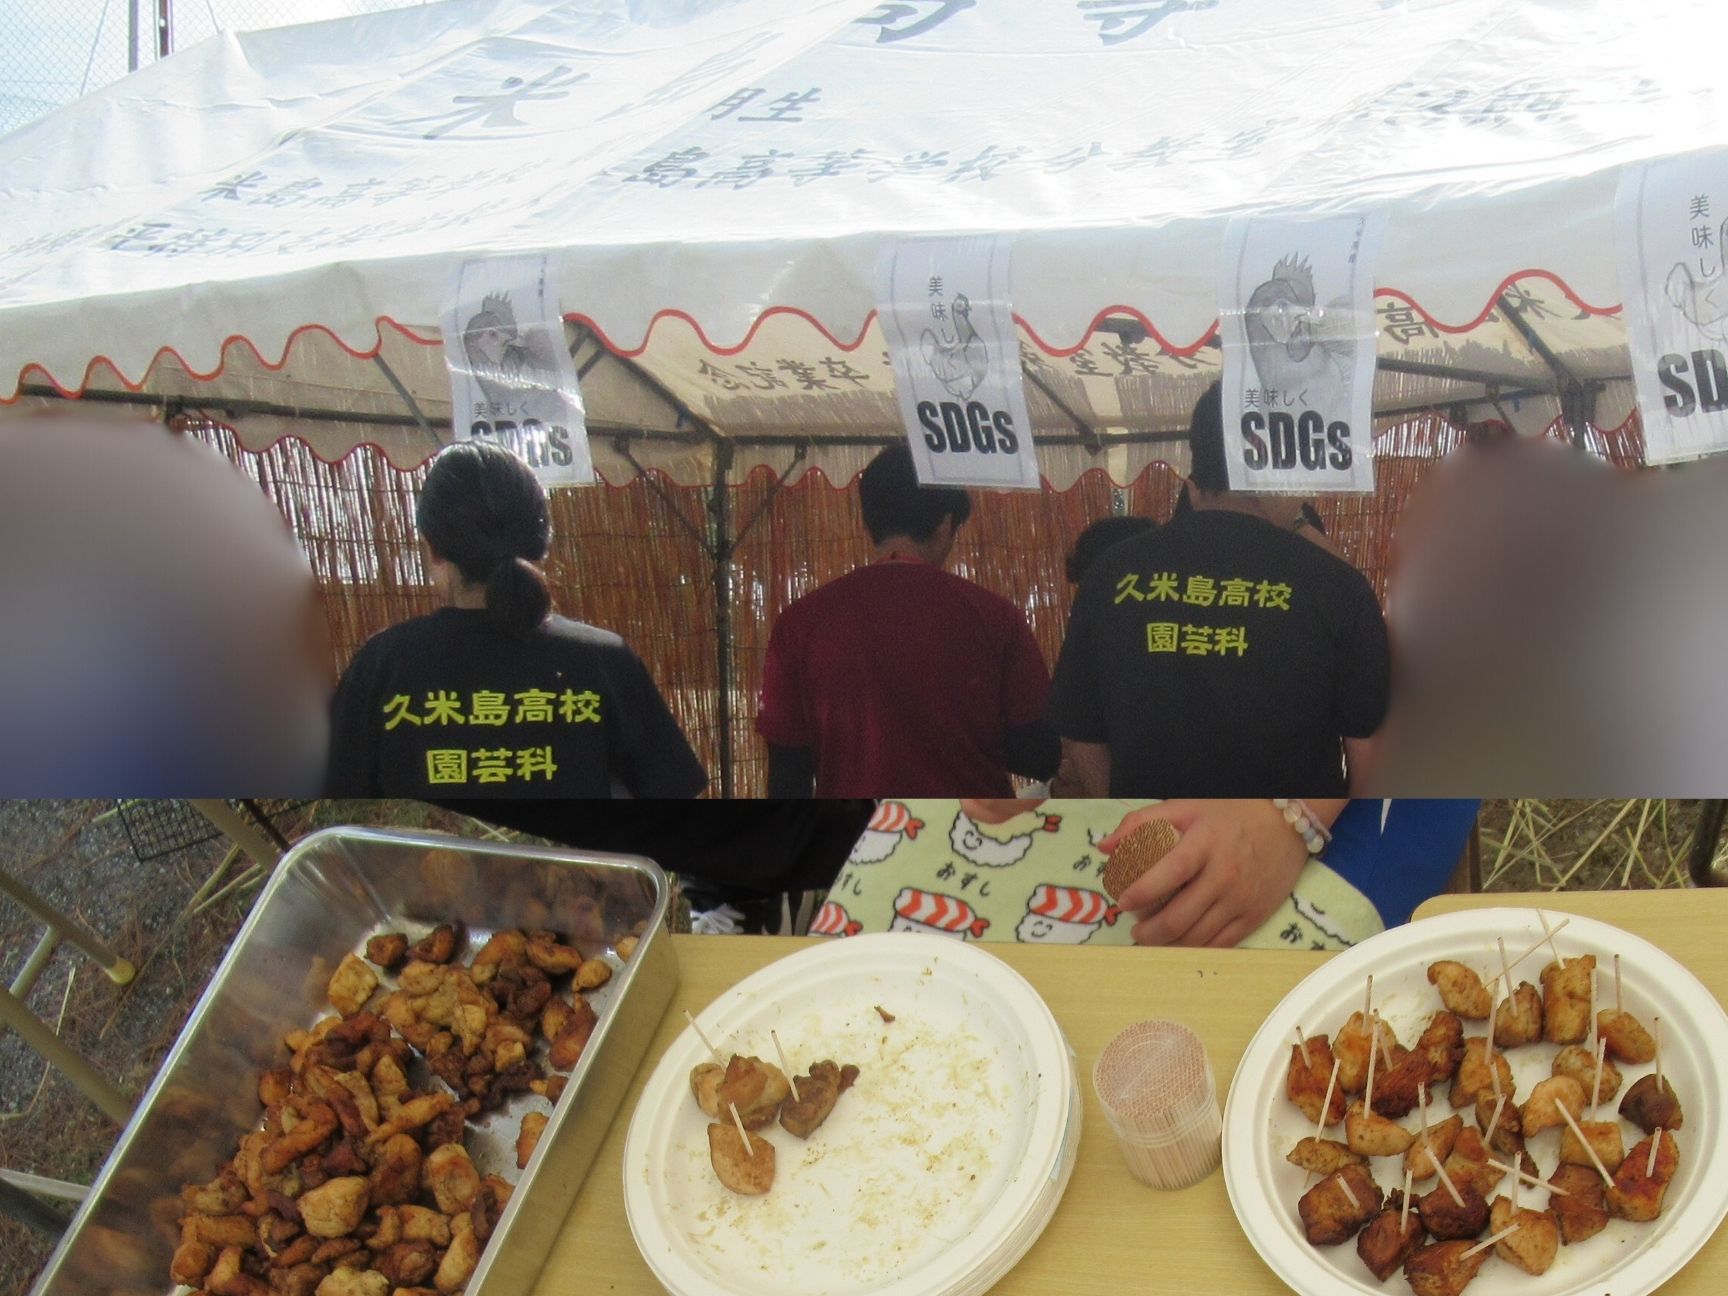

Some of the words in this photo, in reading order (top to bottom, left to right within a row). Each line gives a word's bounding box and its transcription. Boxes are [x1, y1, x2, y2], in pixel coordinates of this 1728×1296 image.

[1245, 388, 1308, 408] 美味しく
[917, 400, 1019, 454] SDGs
[1240, 410, 1353, 471] SDGs
[1113, 572, 1293, 612] 久米島高校
[1146, 621, 1249, 658] 園芸科
[382, 688, 602, 729] 久米島高校
[426, 747, 558, 786] 園芸科
